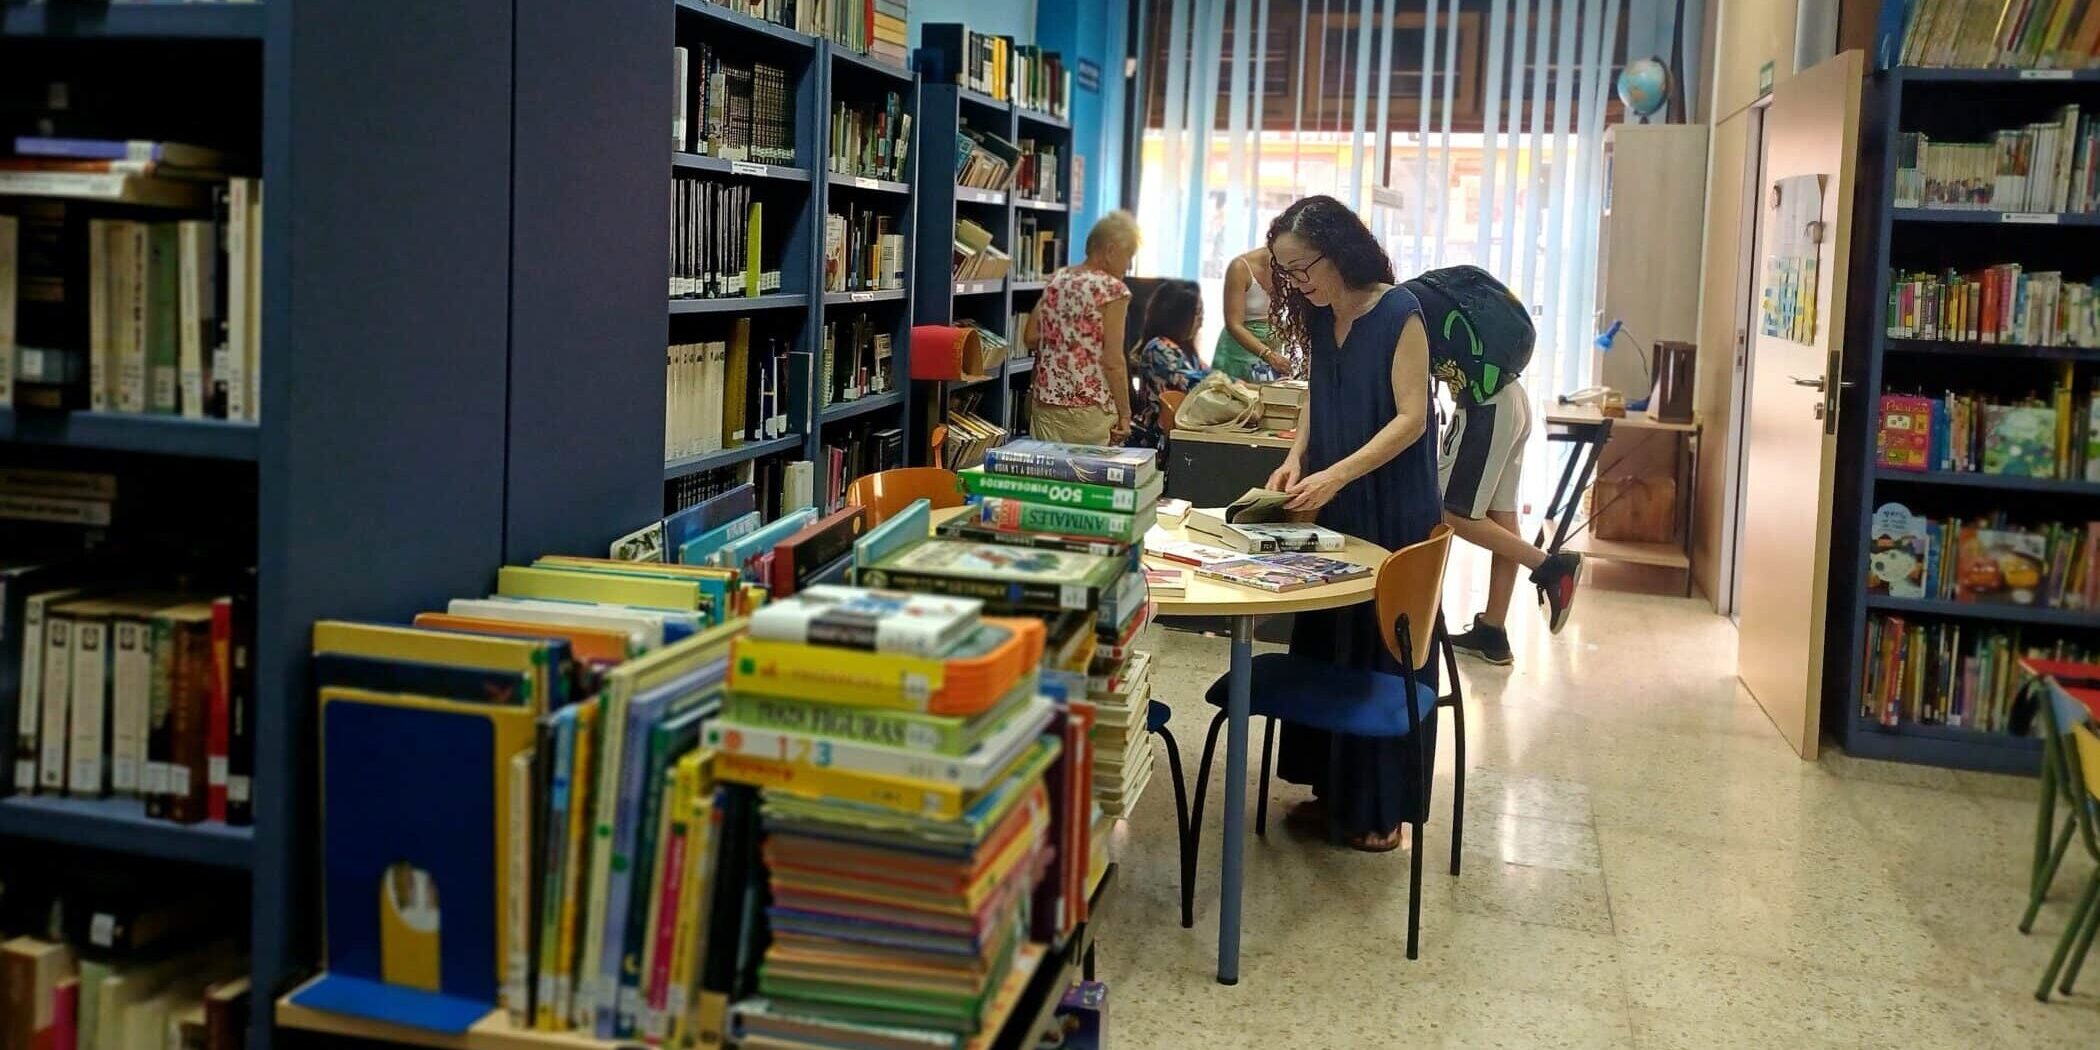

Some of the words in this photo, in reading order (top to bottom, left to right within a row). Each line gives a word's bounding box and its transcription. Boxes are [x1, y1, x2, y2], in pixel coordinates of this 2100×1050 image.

[979, 477, 1049, 494] DINOSAURIOS
[1048, 486, 1083, 503] 500
[1029, 508, 1105, 531] ANIMALES
[778, 736, 788, 761] 1
[794, 738, 812, 763] 2
[815, 740, 833, 767] 3
